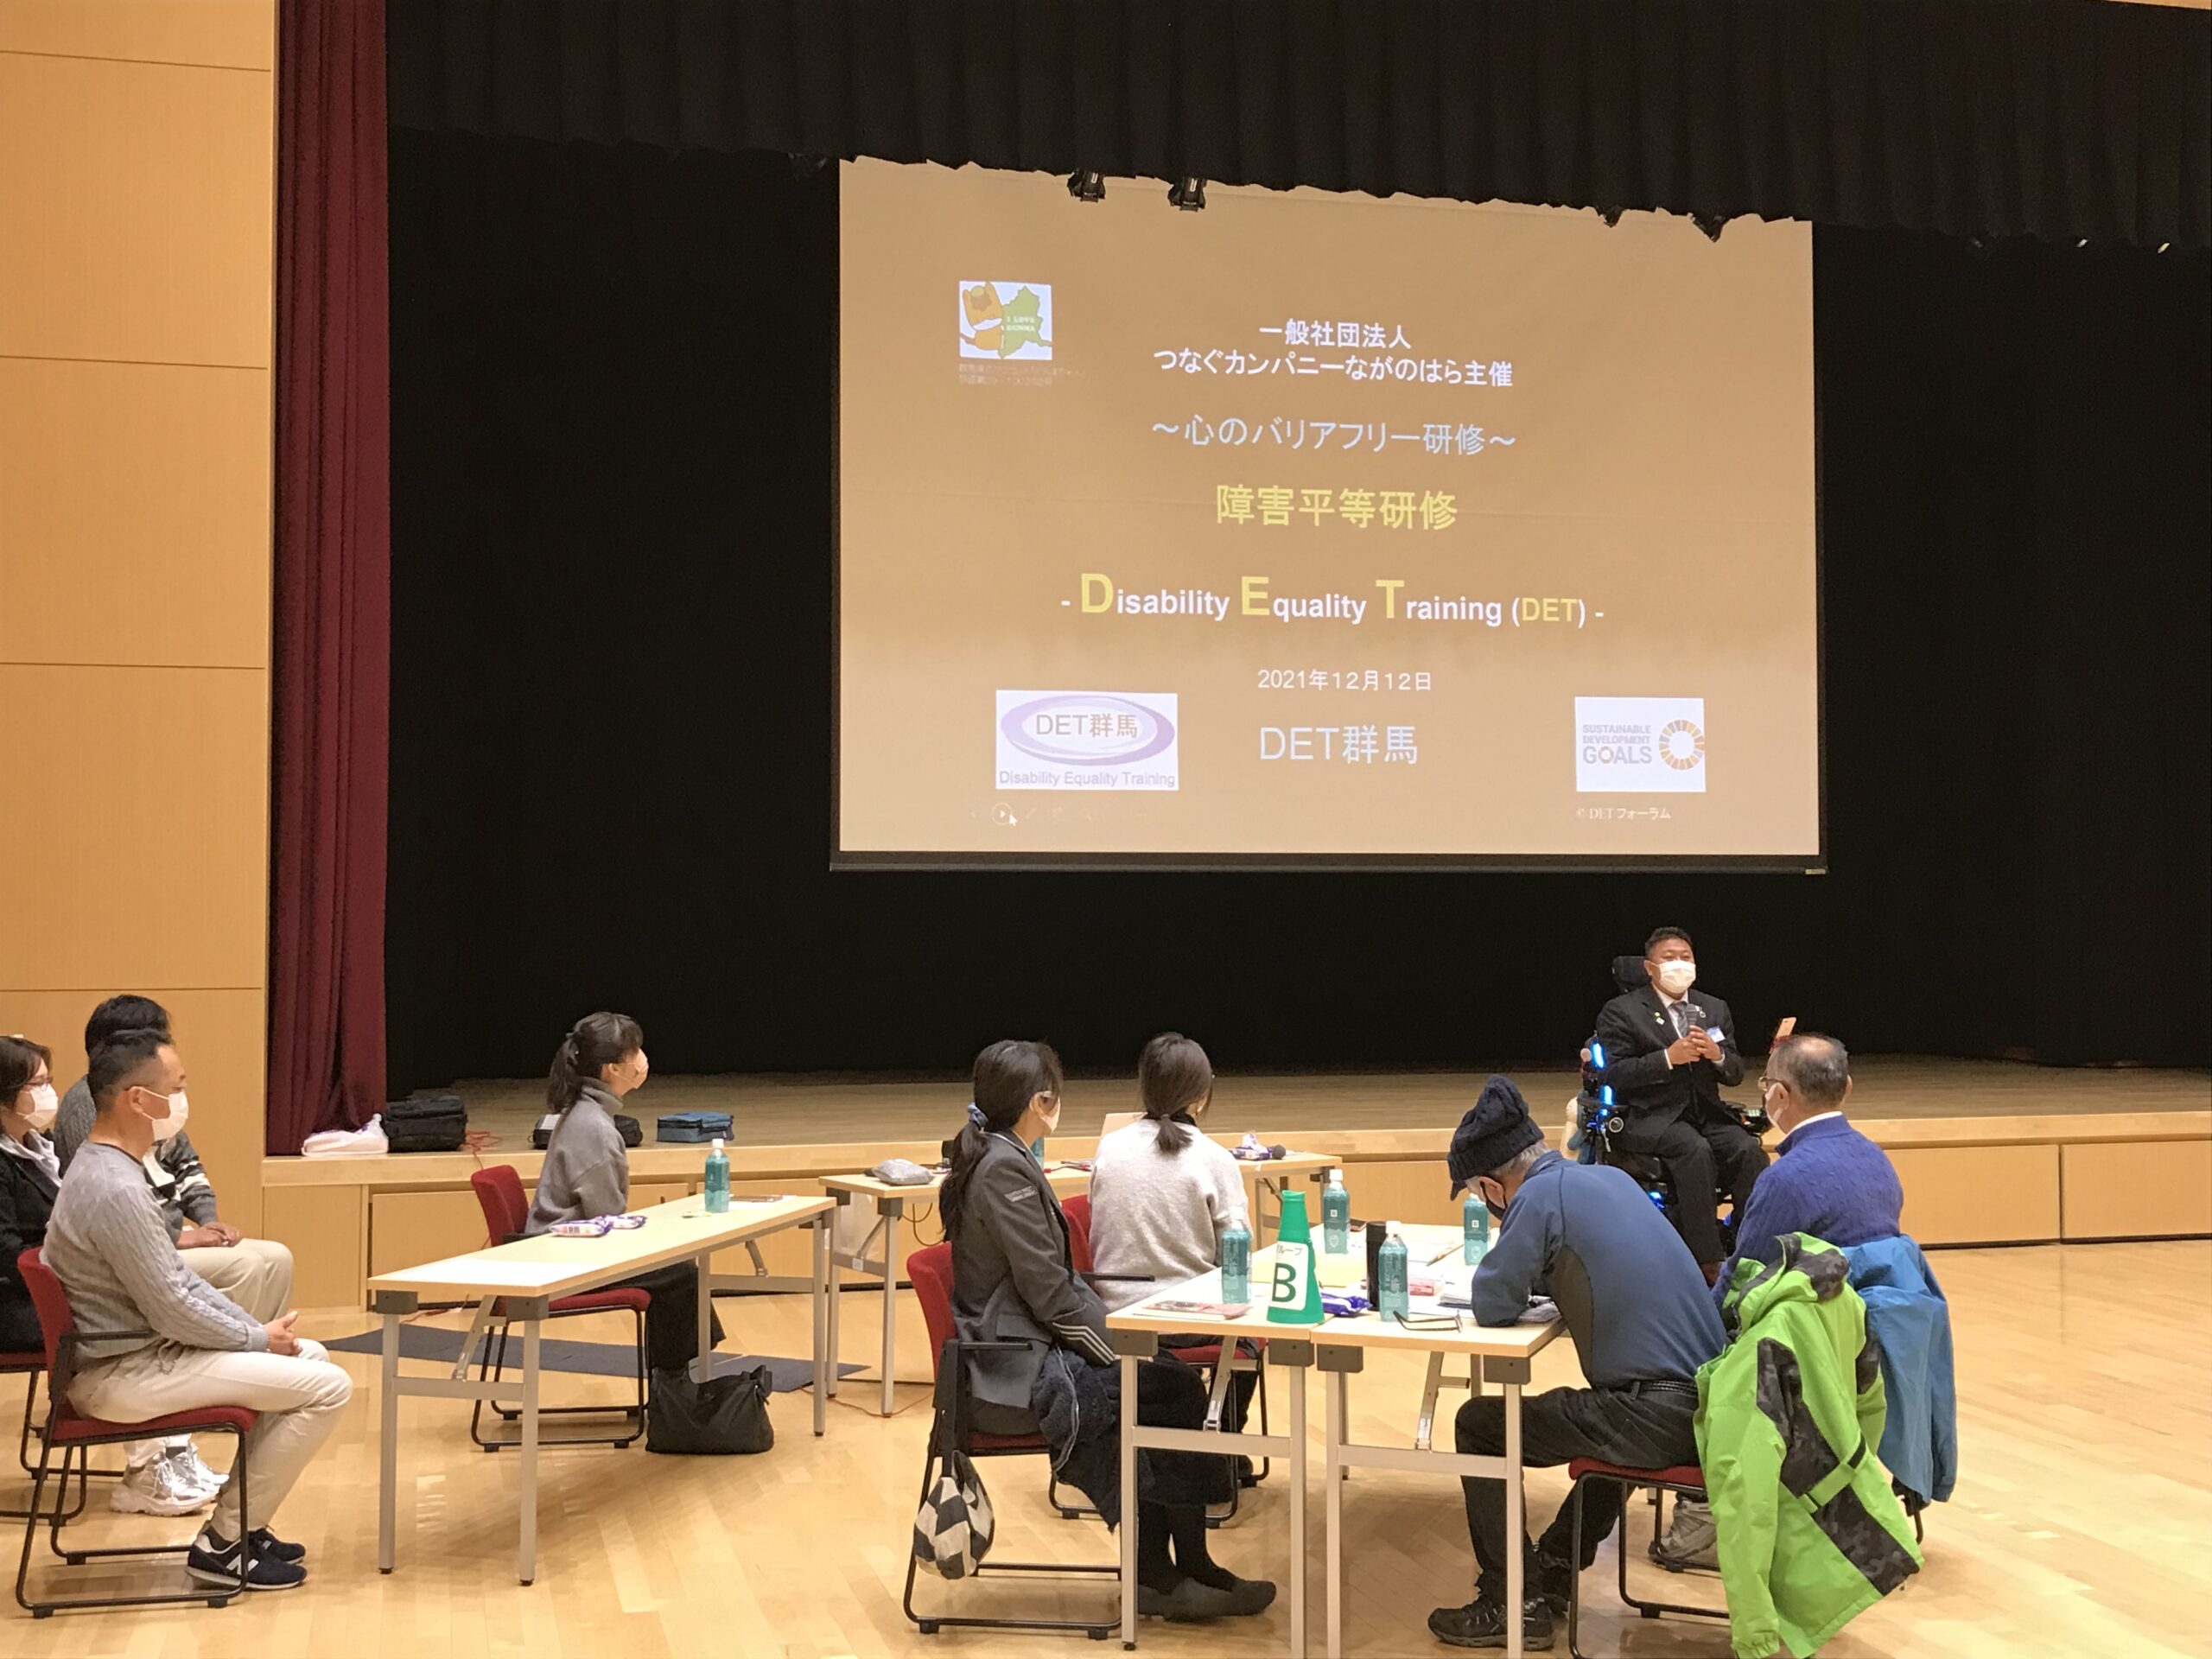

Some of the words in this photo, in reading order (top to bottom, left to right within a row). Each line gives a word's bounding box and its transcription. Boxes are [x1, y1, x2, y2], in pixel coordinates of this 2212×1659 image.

[1259, 317, 1412, 349] 一般社団法人
[1154, 347, 1514, 387] つなぐカンパニーながのはら主催
[1217, 484, 1459, 531] 障害平等研修
[1081, 573, 1230, 622] Disability
[1242, 575, 1367, 626] Equality
[1376, 579, 1503, 628] Training
[1511, 597, 1586, 629] (DET)
[1036, 713, 1138, 738] DET群馬
[1582, 723, 1651, 734] SUSTAINABLE
[1582, 734, 1650, 745] DEVELOPMENT
[1260, 724, 1419, 765] DET群馬
[1582, 746, 1652, 765] GOALS
[999, 770, 1060, 787] Disability
[1064, 771, 1119, 787] Equality
[1122, 771, 1176, 788] Training
[1271, 1262, 1297, 1303] B
